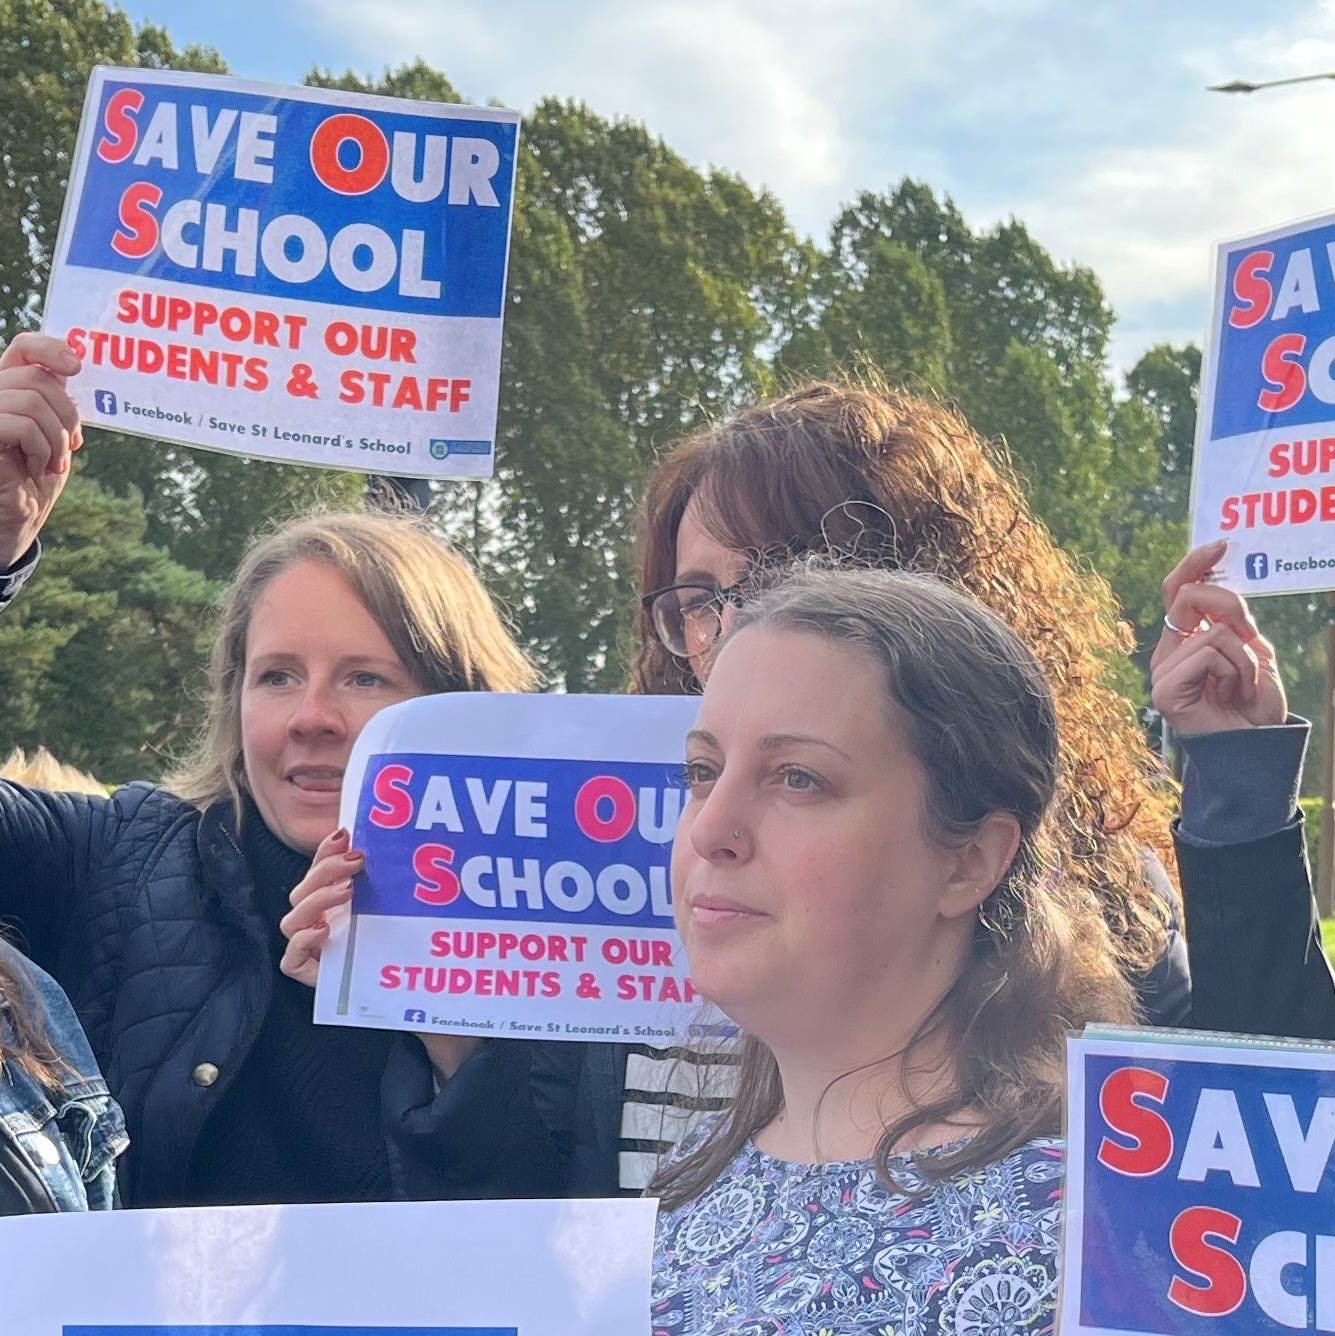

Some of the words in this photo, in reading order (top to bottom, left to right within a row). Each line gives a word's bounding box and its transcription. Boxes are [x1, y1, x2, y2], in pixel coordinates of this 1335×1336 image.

[97, 89, 278, 184] SAVE
[309, 113, 501, 208] OUR
[111, 181, 442, 299] SCHOOL
[116, 290, 307, 350] SUPPORT
[324, 321, 417, 364] OUR
[67, 327, 270, 391] STUDENTS
[286, 364, 320, 398] &
[339, 370, 471, 412] STAFF
[124, 401, 192, 425] Facebook
[209, 417, 246, 435] Save
[251, 424, 267, 438] St
[274, 426, 353, 449] Leonard's
[359, 437, 411, 455] School
[369, 764, 548, 838] SAVE
[574, 775, 691, 844] OU
[412, 843, 674, 918] SCHOOL
[379, 965, 561, 998] STUDENTS
[575, 972, 602, 1000] &
[430, 930, 587, 962] SUPPORT
[602, 938, 674, 967] OUR
[431, 1016, 495, 1030] Facebook
[509, 1021, 543, 1032] Save
[546, 1022, 561, 1033] St
[565, 1024, 629, 1036] Leonard's
[634, 1026, 675, 1037] School
